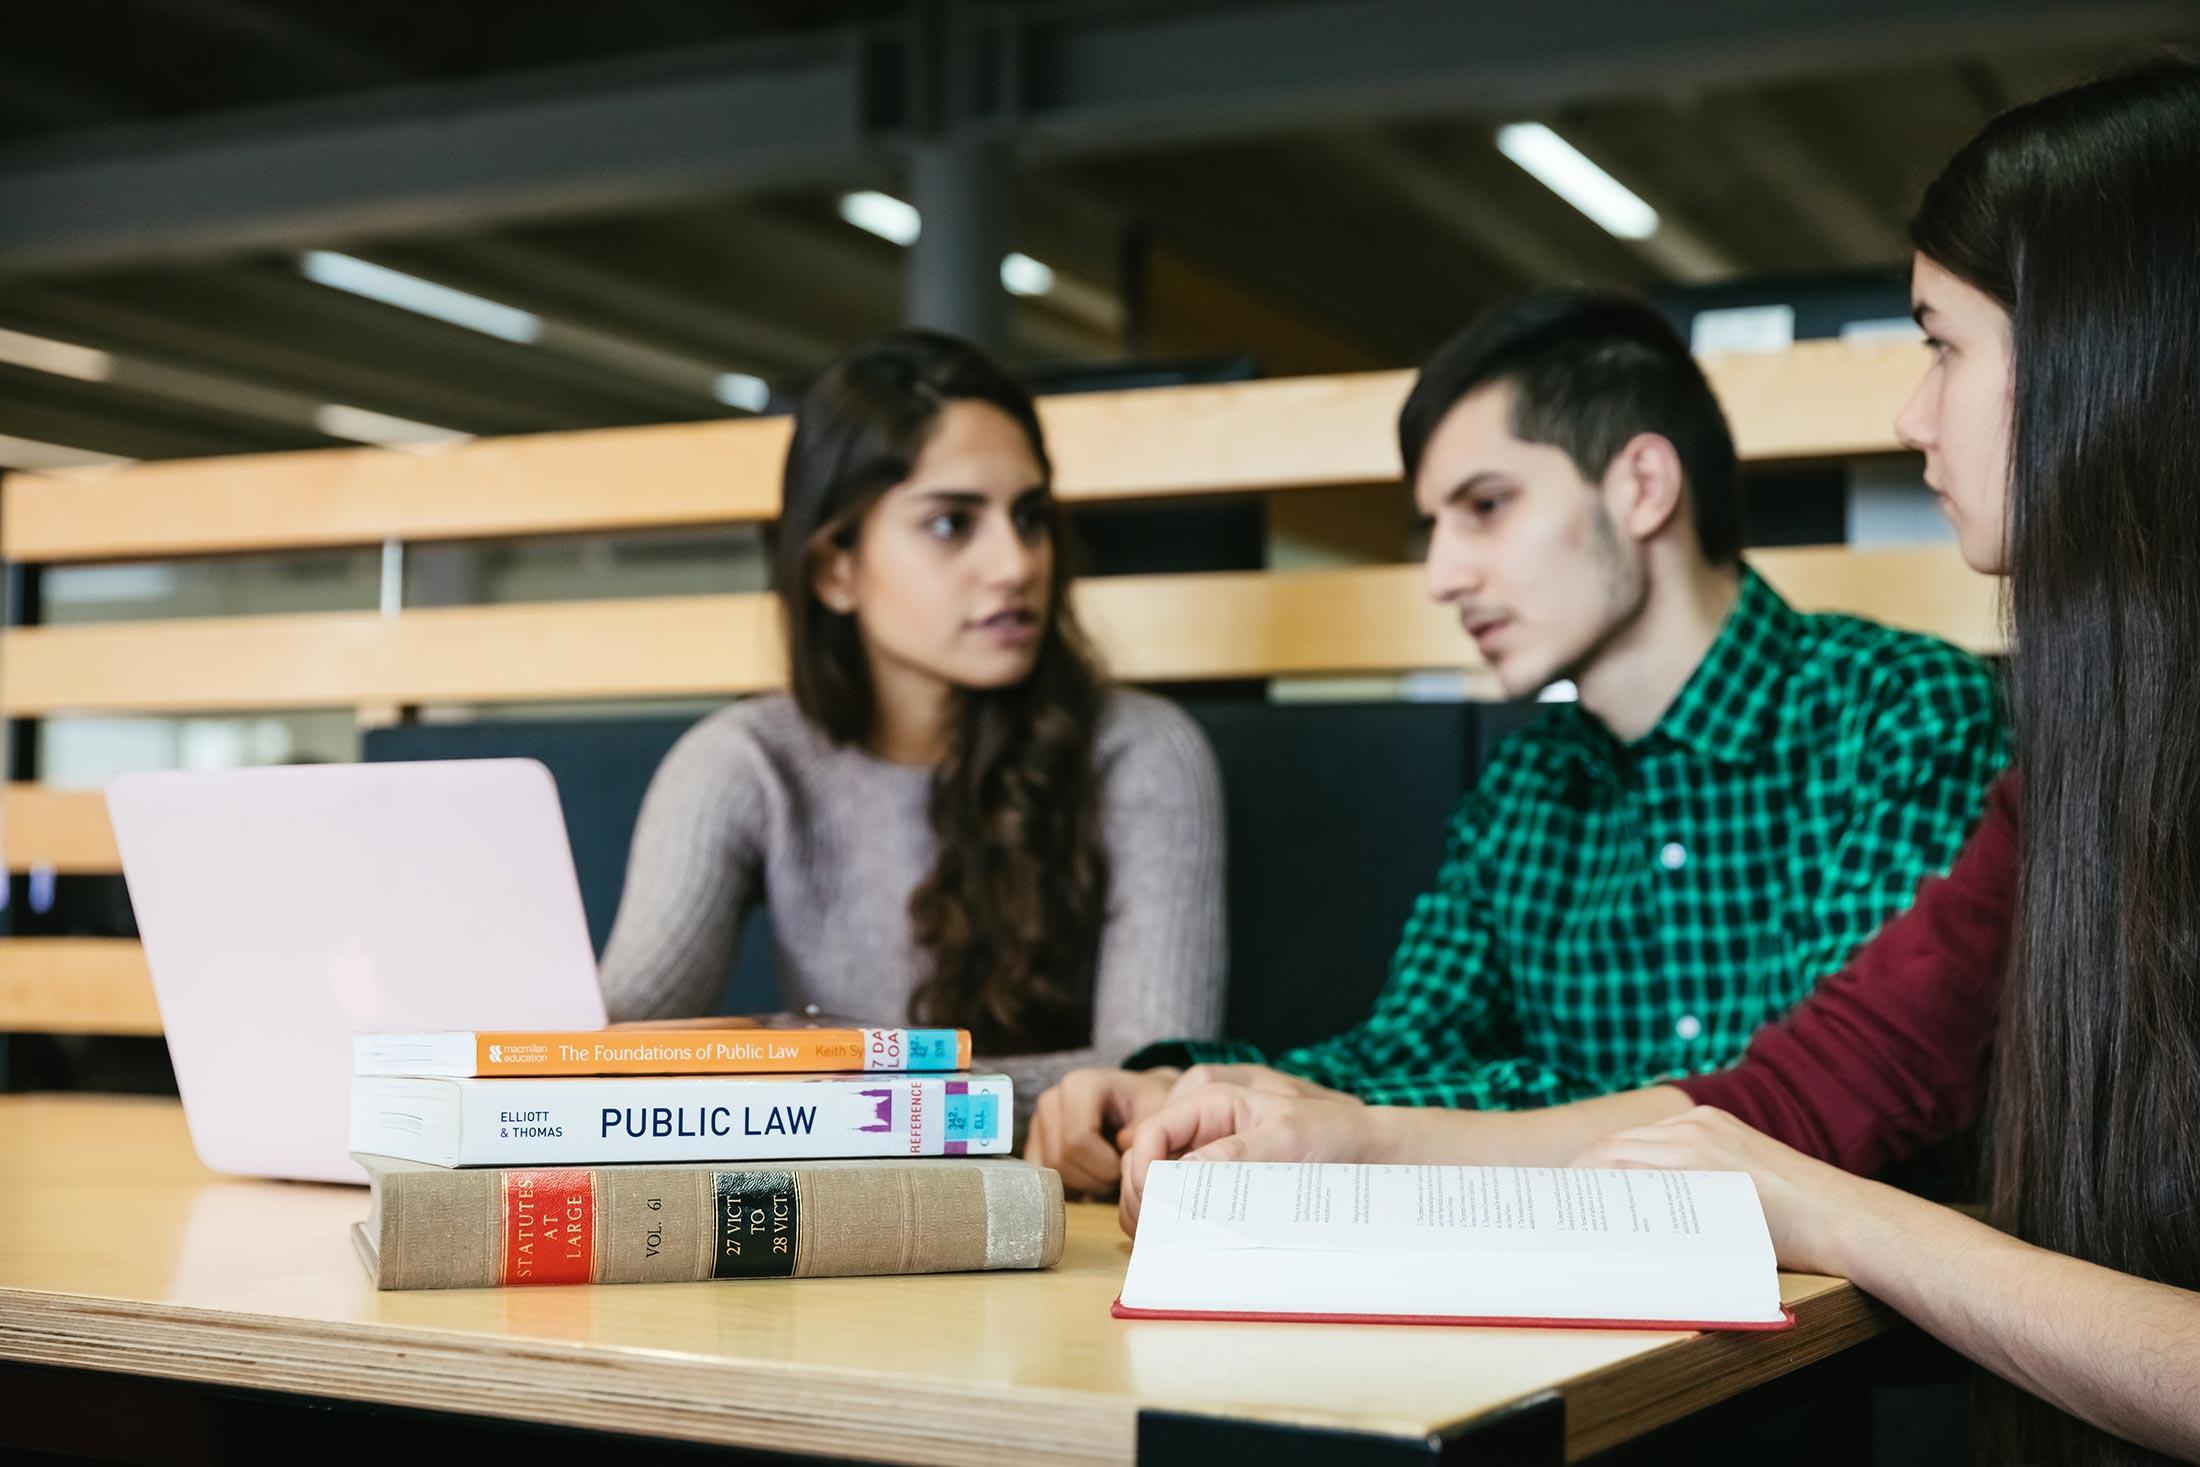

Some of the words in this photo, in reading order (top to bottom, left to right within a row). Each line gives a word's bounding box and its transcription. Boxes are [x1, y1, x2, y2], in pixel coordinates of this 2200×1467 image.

[503, 1044, 548, 1053] macmillan
[558, 1044, 590, 1062] The
[594, 1044, 692, 1062] Foundations
[695, 1043, 713, 1061] of
[716, 1043, 765, 1060] Public
[768, 1043, 800, 1060] Law
[815, 1044, 847, 1058] Keith
[849, 1044, 864, 1061] Sy
[872, 1031, 884, 1054] DA
[887, 1032, 900, 1068] LOA
[503, 1053, 548, 1063] education
[872, 1060, 884, 1069] 7
[500, 1111, 550, 1123] ELLIOTT
[601, 1106, 731, 1138] PUBLIC
[744, 1105, 817, 1136] LAW
[910, 1082, 922, 1153] REFERENCE
[500, 1127, 509, 1138] &
[512, 1126, 563, 1138] THOMAS
[647, 1198, 662, 1211] 61
[726, 1191, 742, 1235] VICT.
[773, 1190, 789, 1233] VICT.
[517, 1180, 535, 1278] STATUTES
[543, 1214, 559, 1241] AT
[566, 1195, 583, 1259] LARGE
[750, 1208, 766, 1236] TO
[646, 1221, 662, 1258] VOL.
[726, 1238, 742, 1257] 27
[772, 1236, 788, 1255] 28
